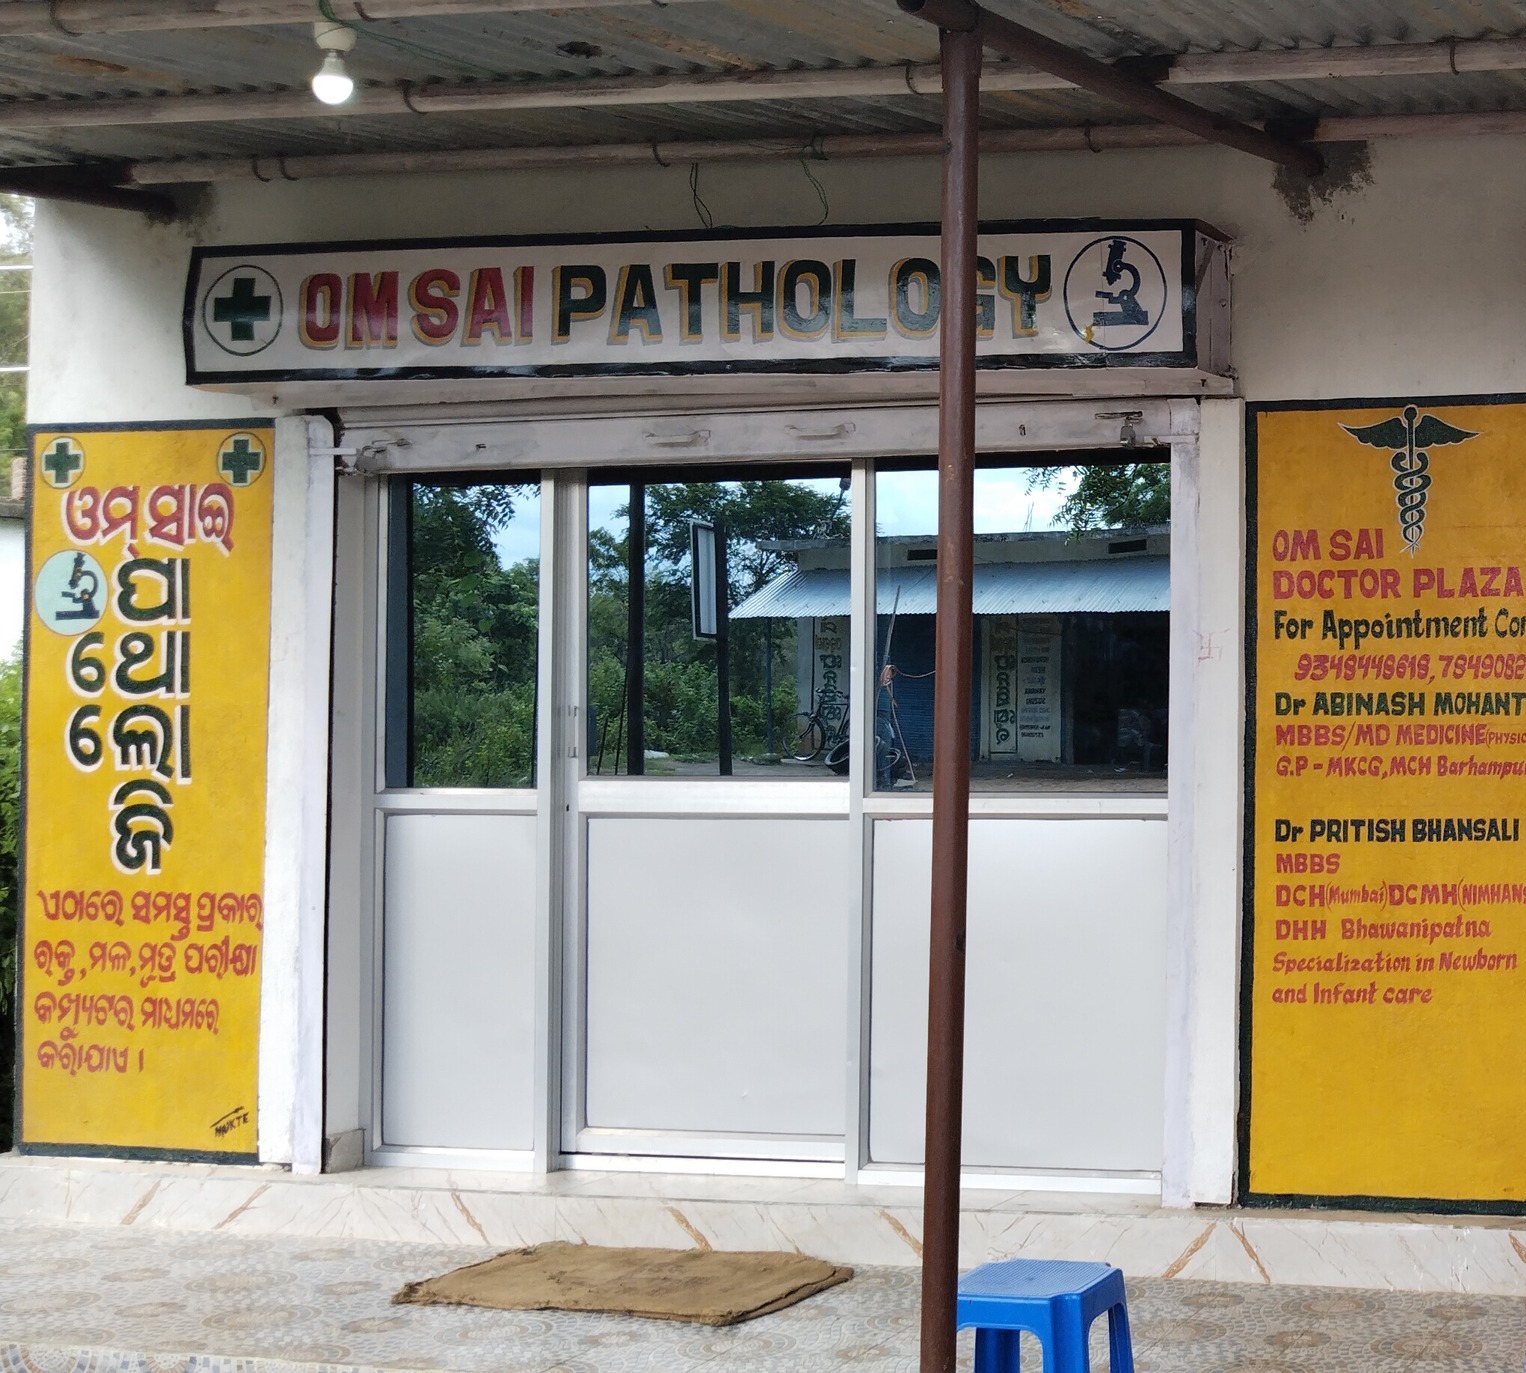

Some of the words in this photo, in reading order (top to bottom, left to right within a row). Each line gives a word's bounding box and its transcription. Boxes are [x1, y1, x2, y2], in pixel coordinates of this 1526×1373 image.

[300, 271, 400, 349] OM
[410, 266, 536, 345] SAI
[1273, 529, 1321, 561] OM
[1329, 528, 1384, 559] SAI
[1273, 568, 1401, 599] DOCTOR
[1413, 566, 1524, 598] PLAZA
[1274, 610, 1313, 640] For
[1322, 606, 1488, 649] Appointment
[1275, 693, 1306, 716] Dr
[1312, 692, 1426, 716] ABINASH
[1276, 721, 1390, 750] MBBS/MD
[1276, 756, 1308, 777] G.P
[1275, 819, 1304, 842] Dr
[1310, 818, 1406, 842] PRITISH
[1412, 818, 1520, 842] BHANSALI
[1276, 853, 1341, 874] MBBS
[1275, 919, 1327, 940] DHH
[1341, 914, 1493, 945] Bhawanipatna
[1272, 951, 1412, 975] Specialization
[1415, 953, 1435, 973] in
[1438, 947, 1519, 973] Newborn
[1272, 982, 1307, 1004] and
[1313, 981, 1378, 1005] Infant
[1382, 987, 1434, 1004] care
